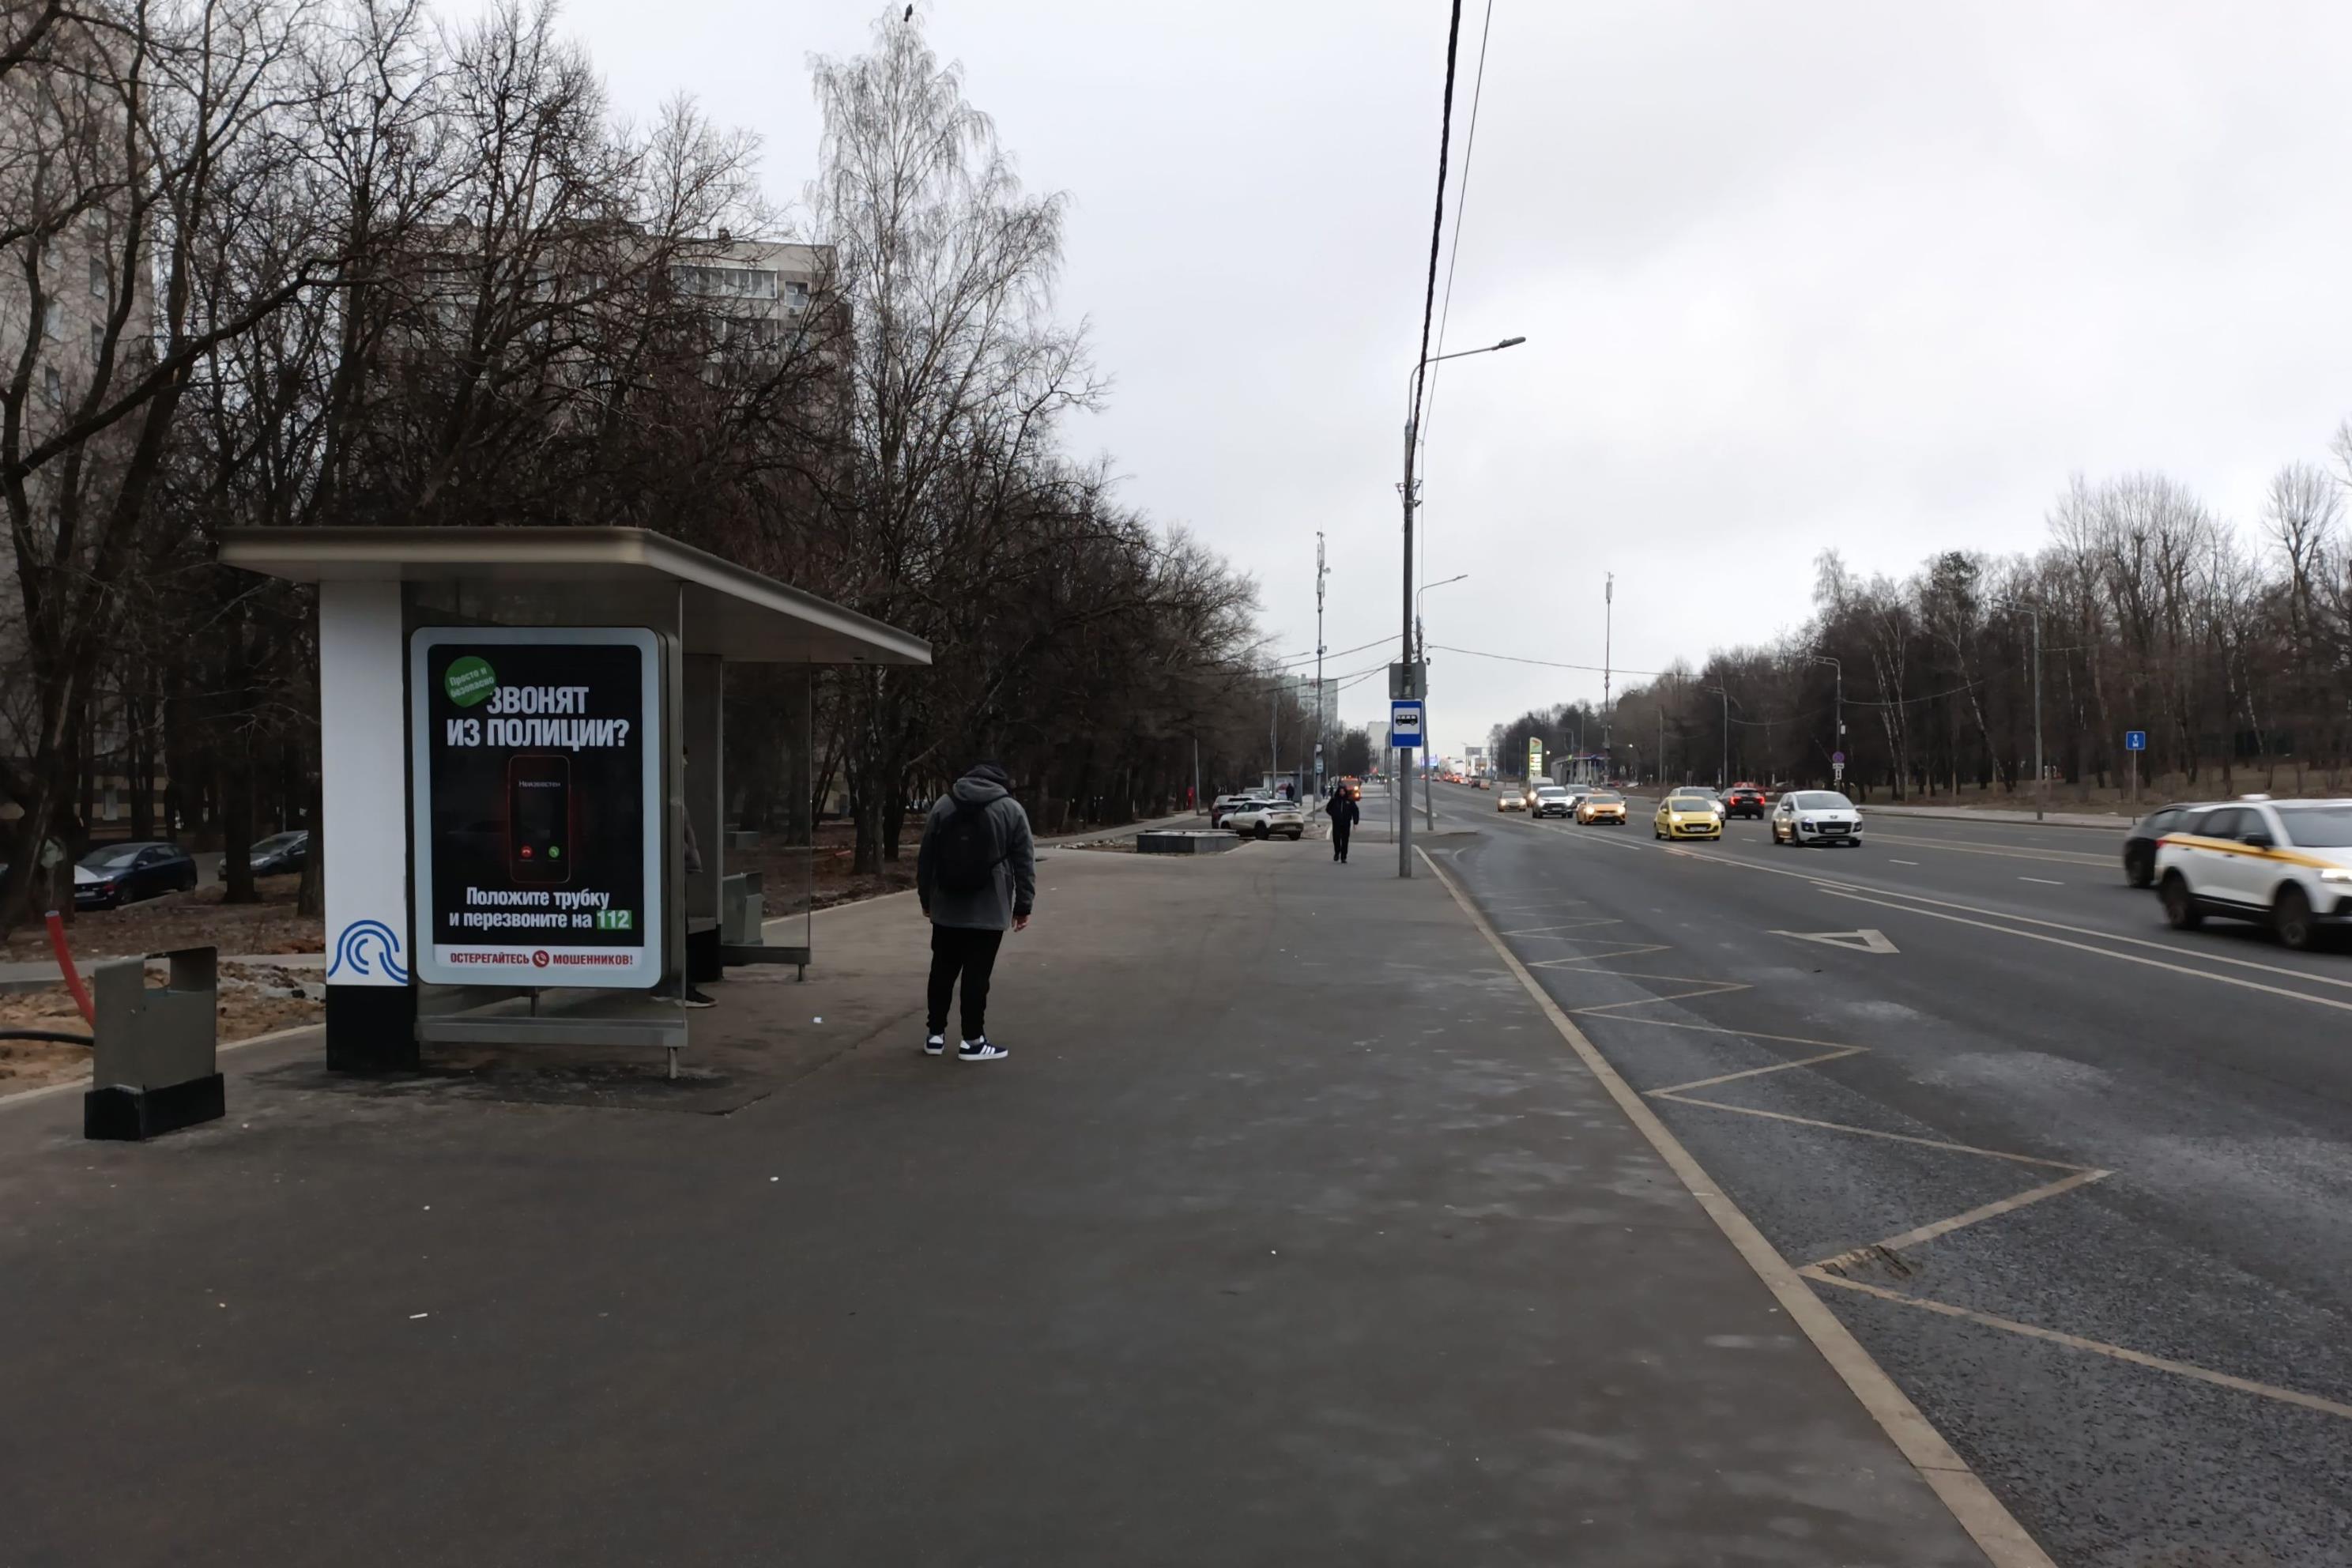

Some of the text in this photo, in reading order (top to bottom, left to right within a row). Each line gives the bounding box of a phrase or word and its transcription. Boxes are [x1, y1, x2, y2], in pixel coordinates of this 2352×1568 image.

[449, 670, 479, 687] Просто
[487, 686, 590, 714] ЗВОНЯТ
[447, 718, 630, 752] ИЗ ПОЛИЦИИ?
[466, 887, 609, 910] Положите трубку
[449, 910, 630, 931] и перезвоните на 112
[450, 952, 633, 965] ОСТЕРЕГАЙТЕСЬ МОШЕННИКОВ!
